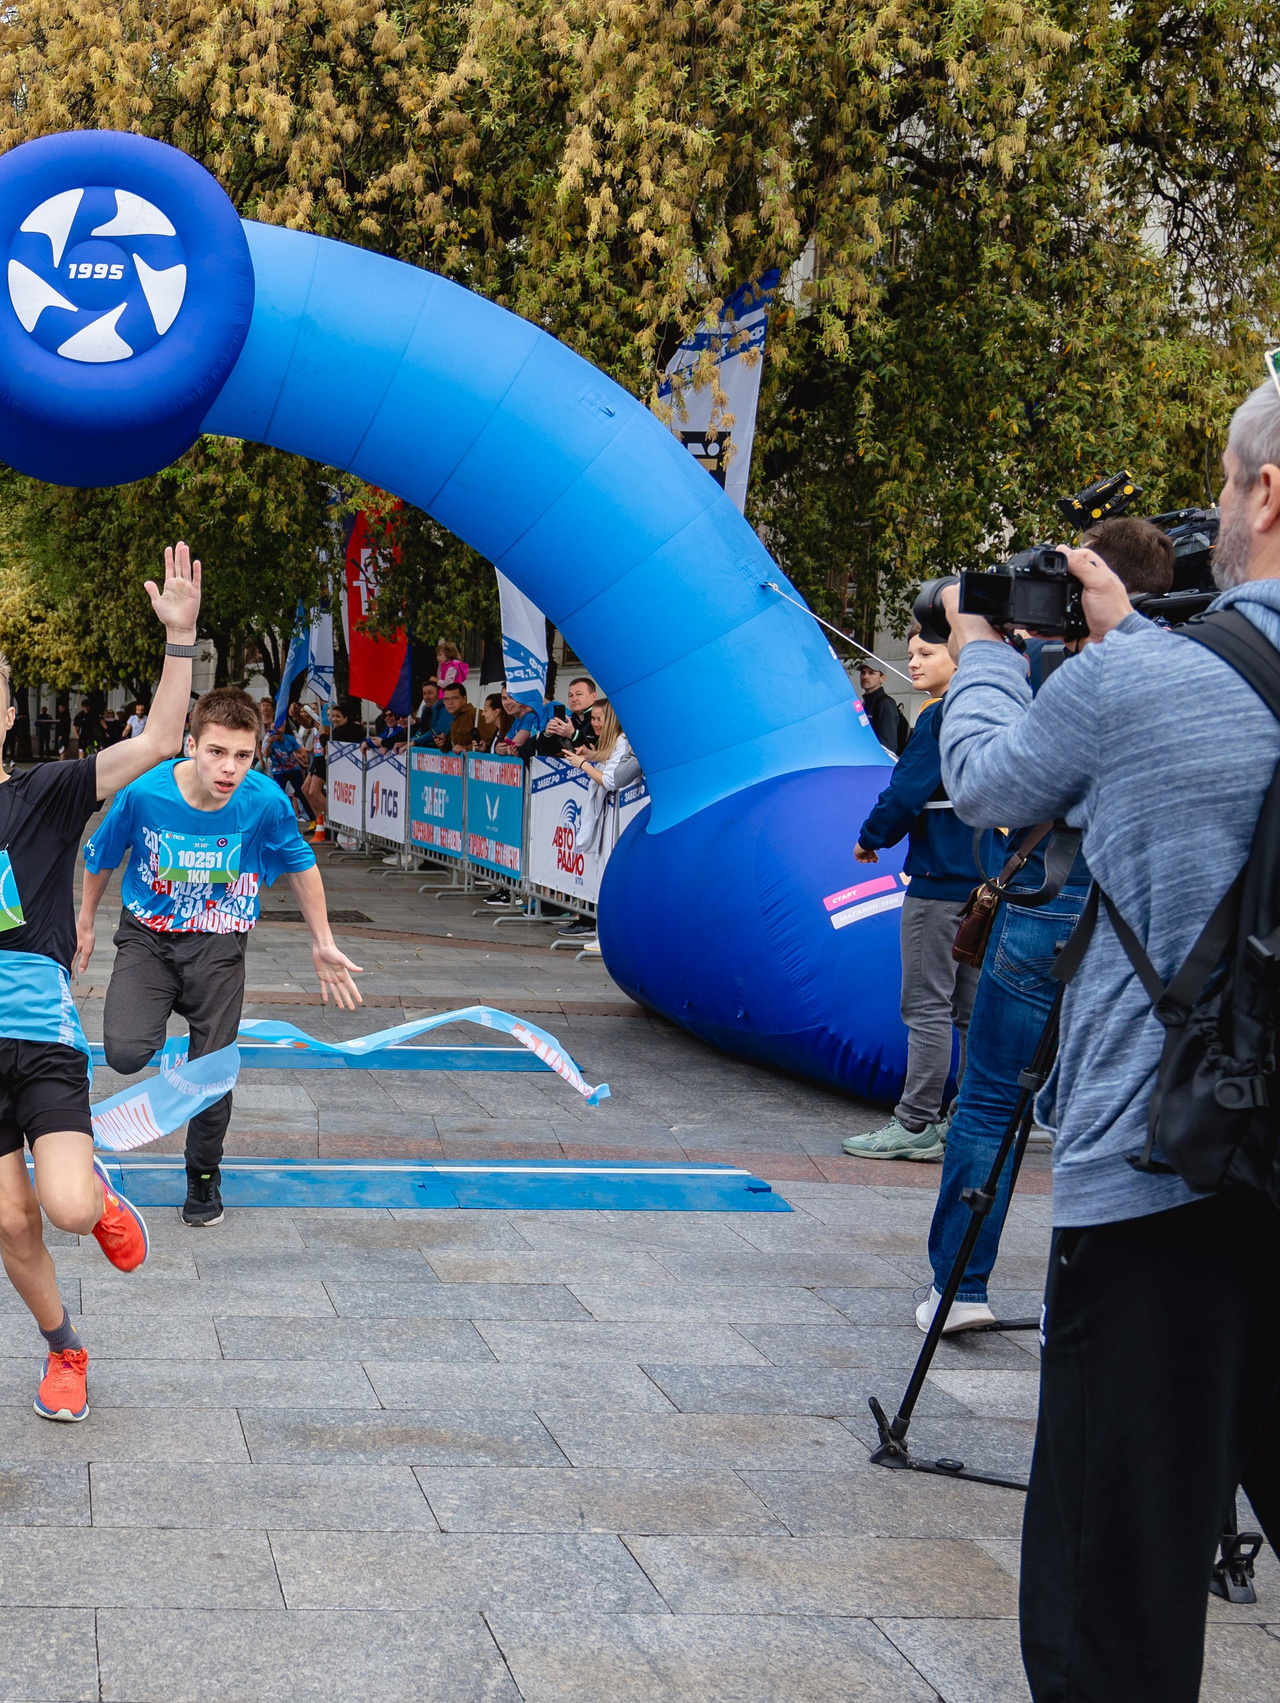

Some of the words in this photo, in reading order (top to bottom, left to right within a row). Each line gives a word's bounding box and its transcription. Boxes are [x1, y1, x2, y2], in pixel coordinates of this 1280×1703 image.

[68, 263, 125, 280] 1995
[537, 774, 560, 789] ЗАБЕГ.РФ
[333, 780, 356, 806] FONBET
[624, 784, 646, 803] ЗАБЕГ.РФ
[380, 788, 399, 819] ПСБ
[552, 826, 574, 851] АВТО
[178, 850, 223, 869] 10251
[557, 850, 585, 877] РАДИО
[186, 869, 211, 884] 1КМ
[832, 889, 858, 904] СТАРТ
